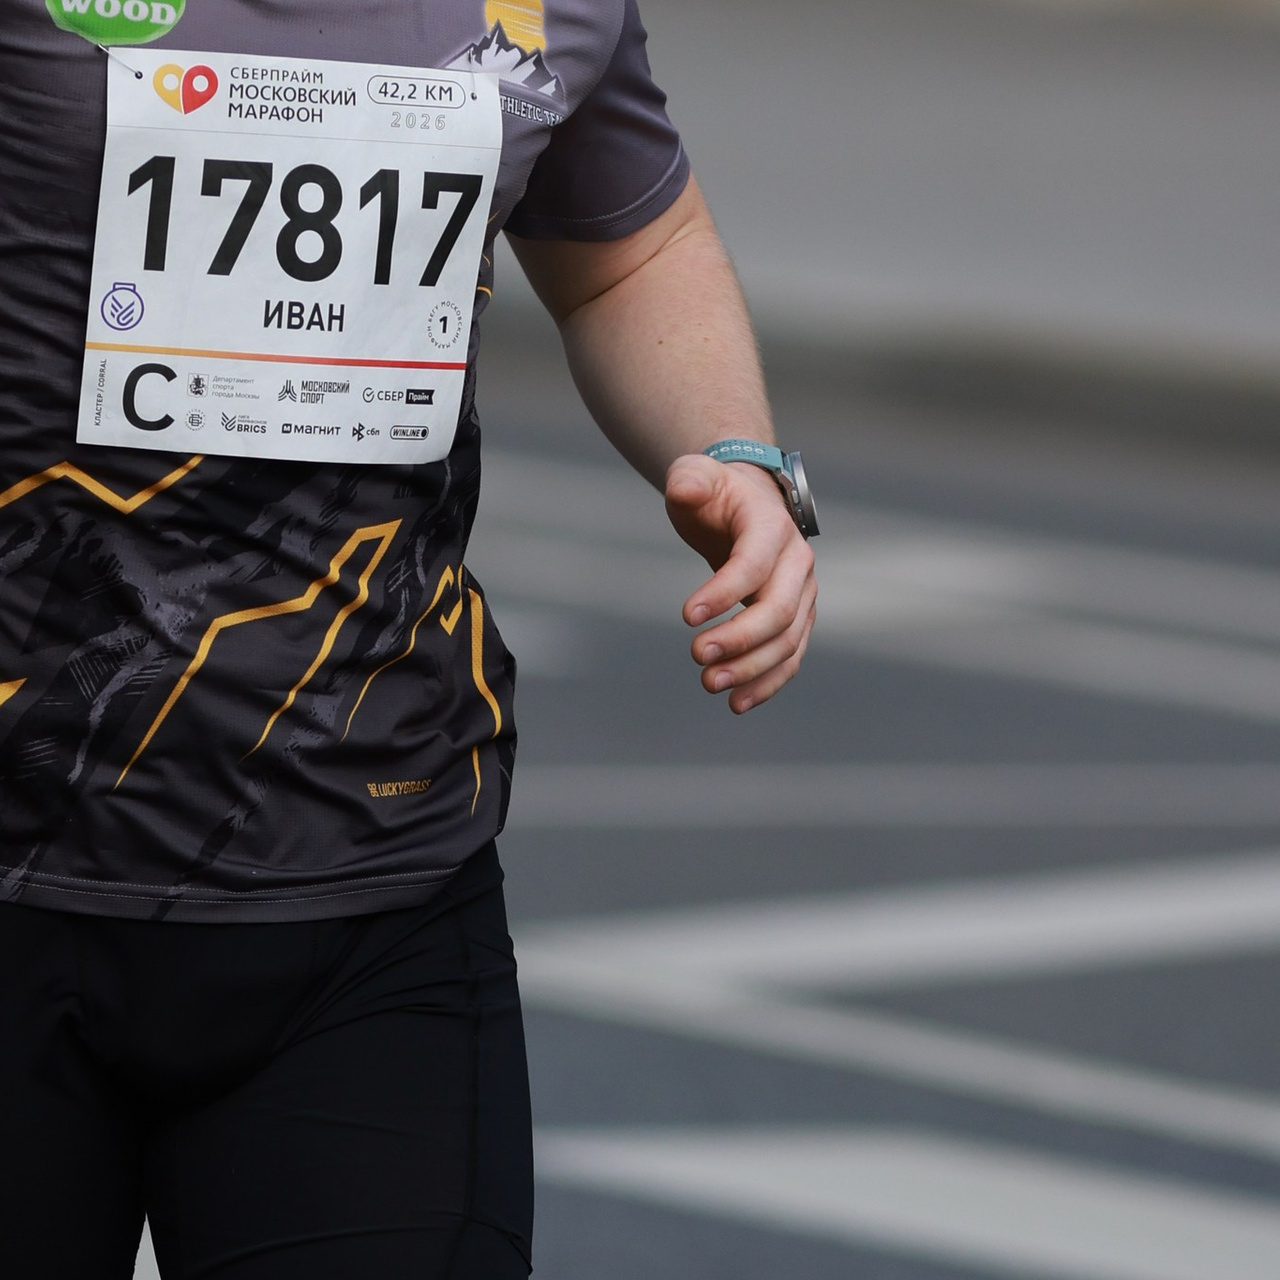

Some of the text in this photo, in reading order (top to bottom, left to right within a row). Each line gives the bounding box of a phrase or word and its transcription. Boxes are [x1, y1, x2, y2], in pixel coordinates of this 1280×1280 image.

[230, 66, 324, 84] СБЕРПРАЙМ
[229, 83, 357, 106] МОСКОВСКИЙ
[378, 81, 453, 101] 42,2 КМ
[228, 103, 323, 123] МАРАФОН
[499, 94, 543, 122] THLETIC
[390, 111, 447, 131] 2026
[127, 155, 483, 287] 17817
[263, 299, 345, 332] ИВАН
[439, 316, 448, 334] 1
[97, 358, 108, 388] CORRAL
[300, 380, 350, 393] МОСКОВСКИЙ
[377, 391, 404, 401] СБЕР
[122, 363, 178, 431] C
[300, 392, 325, 404] СПОРТ
[94, 393, 104, 427] КЛАСТЕР
[237, 424, 267, 433] BRICS
[366, 428, 380, 436] сбп
[392, 429, 421, 437] WINLINE
